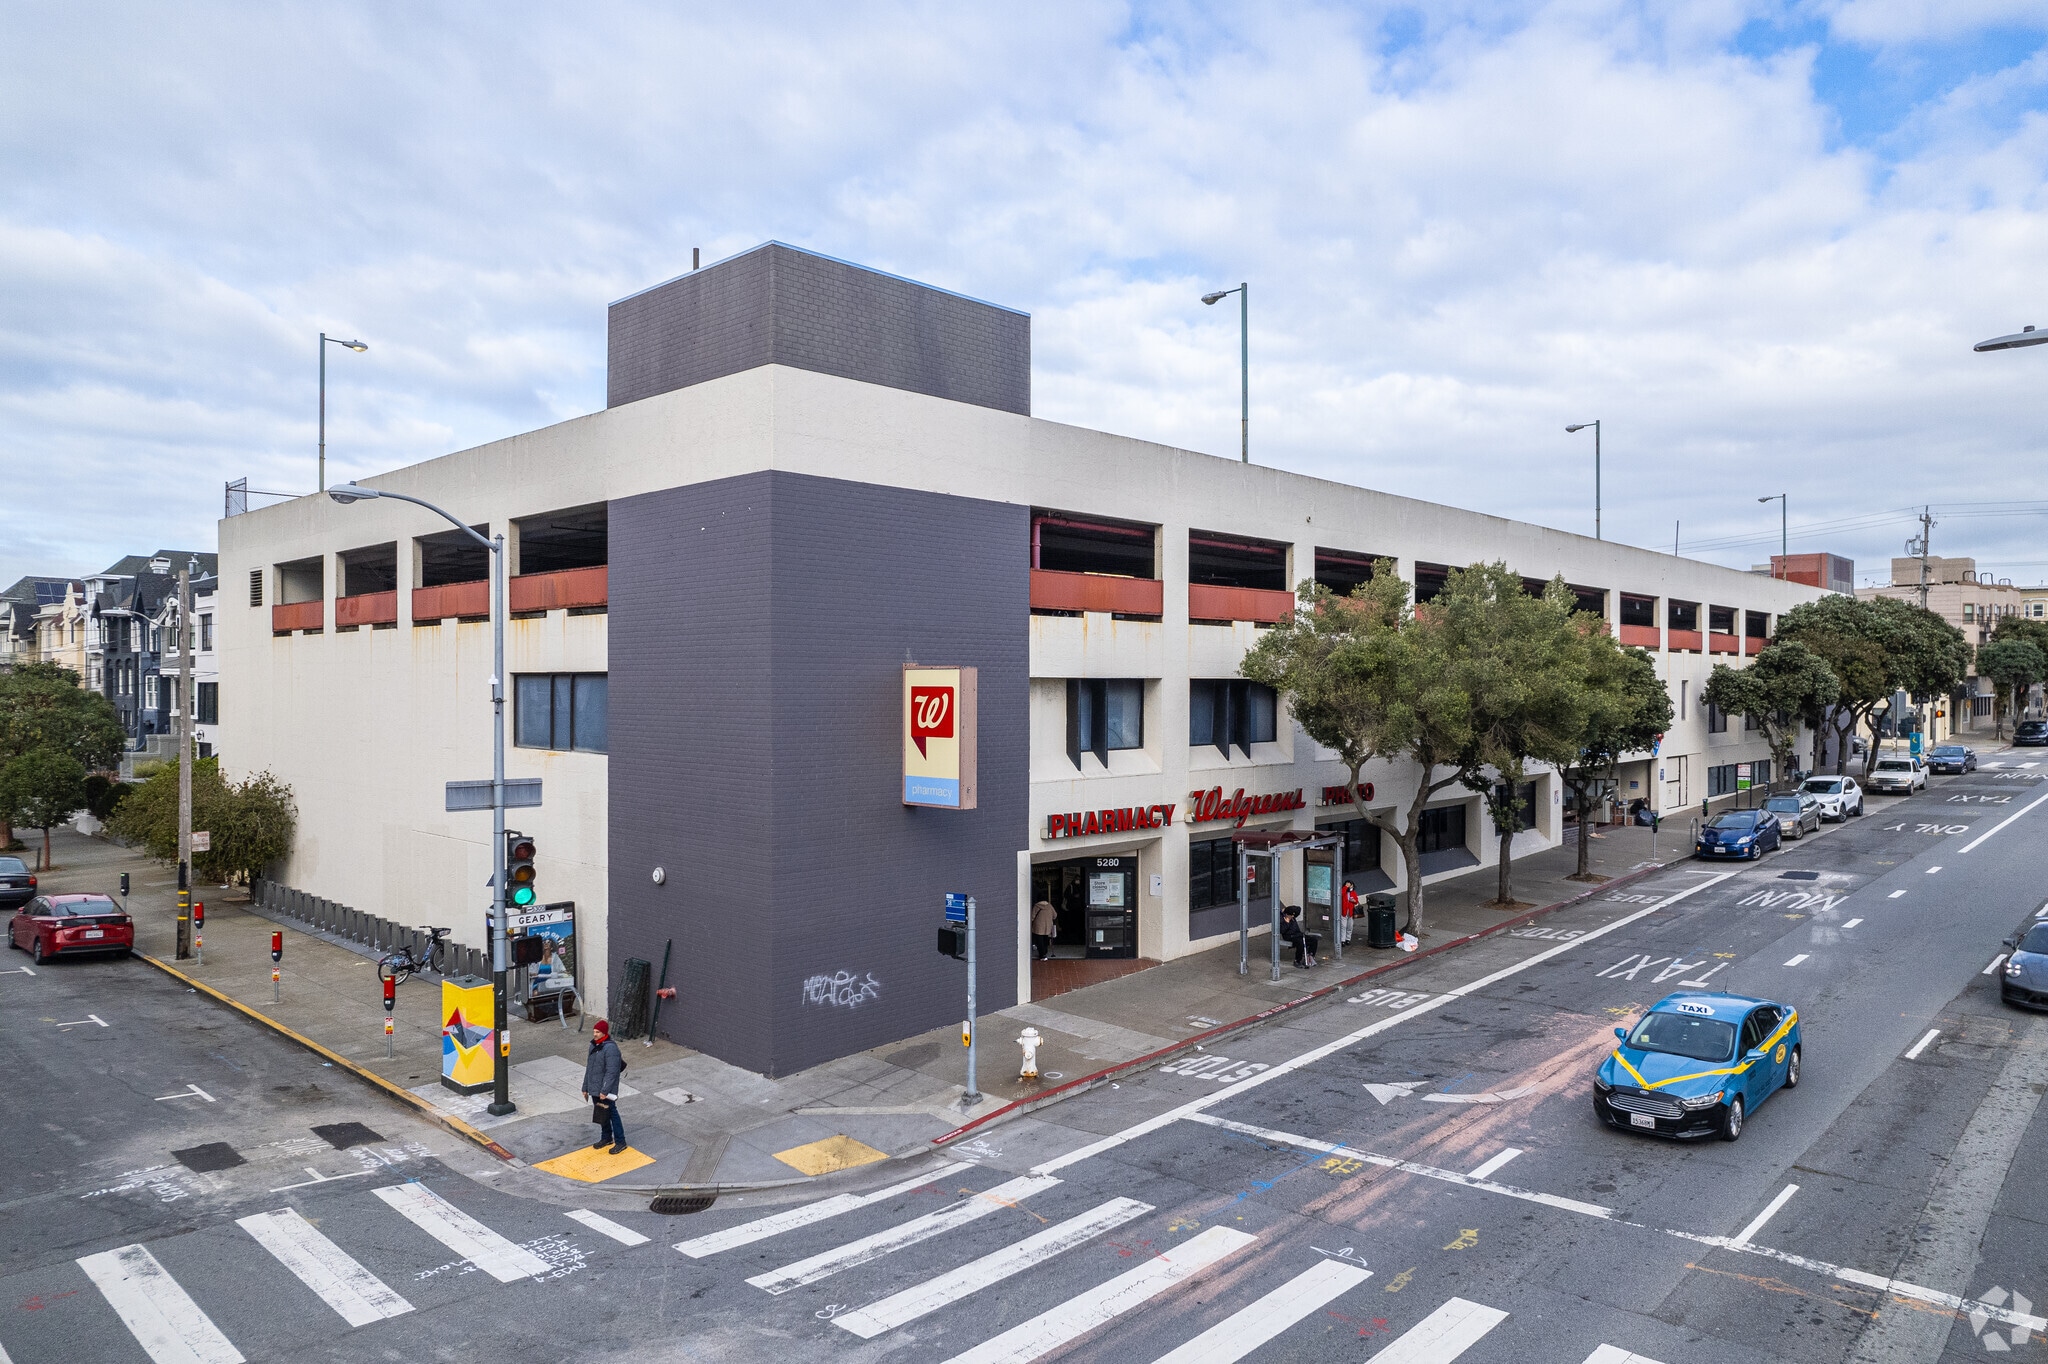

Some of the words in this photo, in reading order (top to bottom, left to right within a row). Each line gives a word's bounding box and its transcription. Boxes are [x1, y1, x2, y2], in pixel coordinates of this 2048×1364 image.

[914, 692, 949, 729] W
[911, 783, 953, 799] pharmacy
[1946, 794, 2013, 804] TAXI
[1188, 785, 1307, 829] Walgreens
[1047, 803, 1177, 840] PHARMACY
[1096, 858, 1120, 867] 5280
[1736, 890, 1850, 912] MUNI
[518, 912, 553, 925] GEARY
[1510, 926, 1587, 941] STOP
[1595, 953, 1730, 988] TAXI
[1347, 988, 1431, 1009] BUS
[1681, 1003, 1709, 1014] TAXI
[1159, 1054, 1270, 1083] STOP
[1648, 1084, 1667, 1093] GOAL
